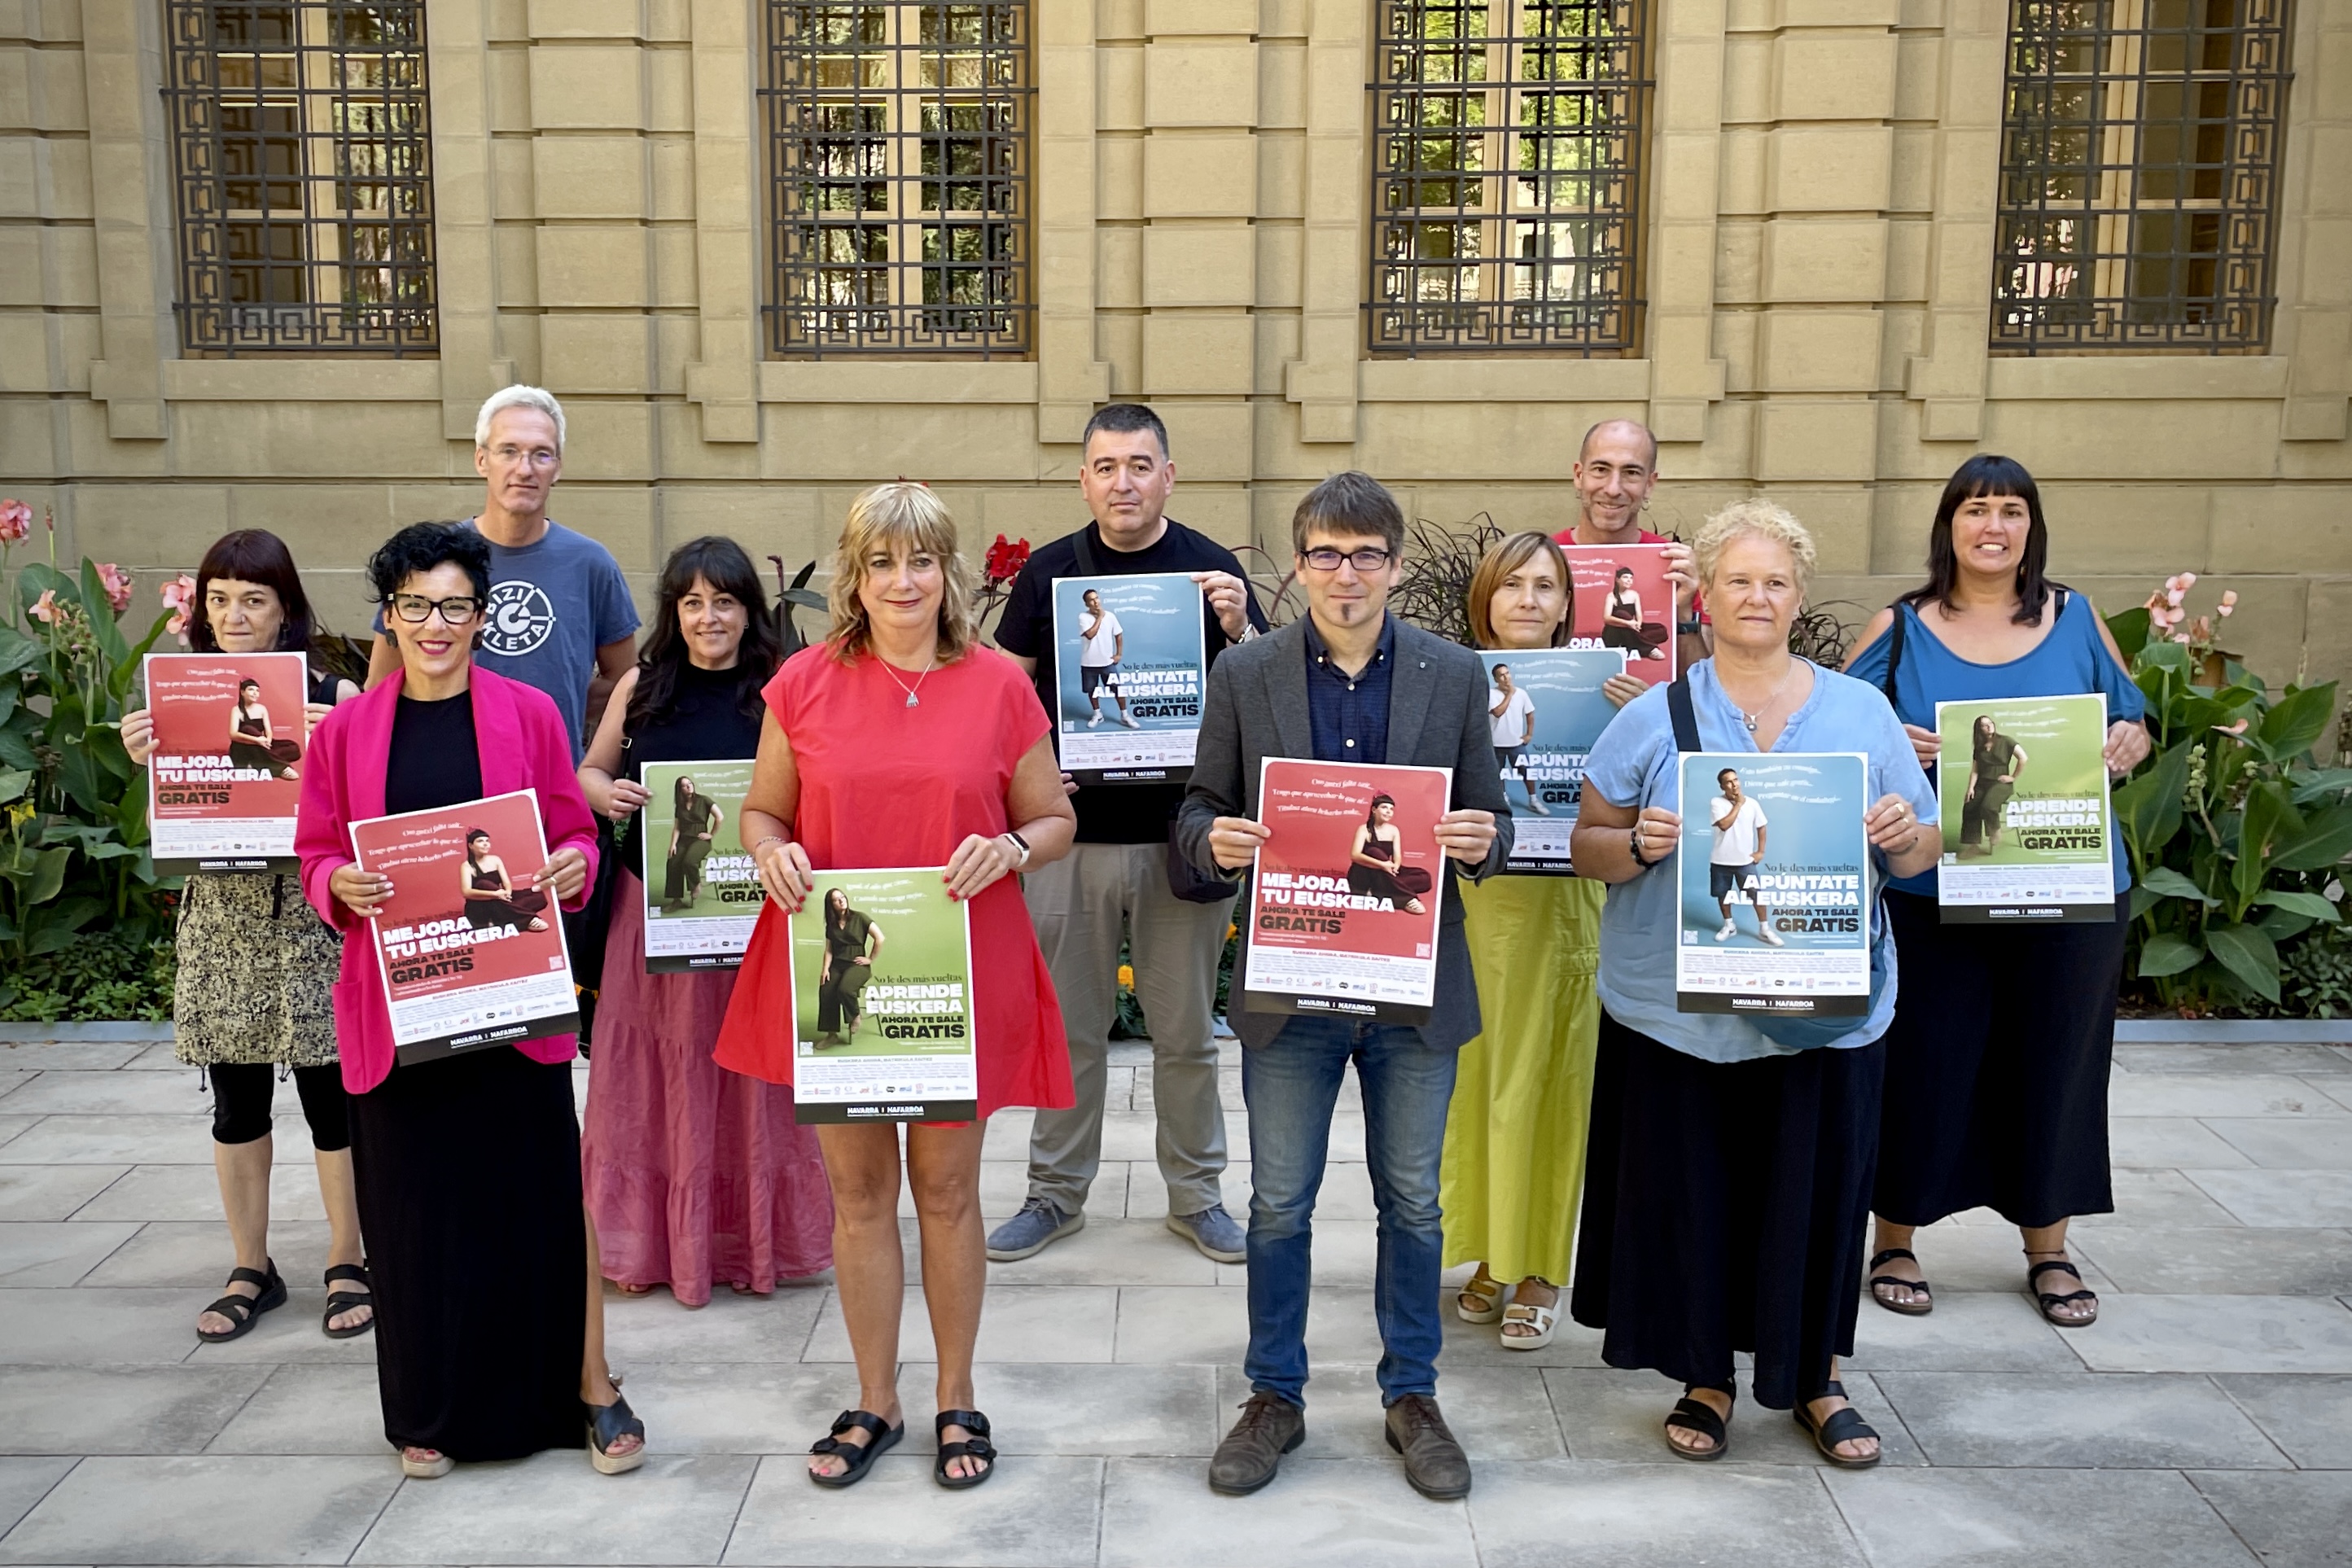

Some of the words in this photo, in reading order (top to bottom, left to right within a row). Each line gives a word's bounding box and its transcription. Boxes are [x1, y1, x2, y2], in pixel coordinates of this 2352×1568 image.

[485, 588, 523, 615] BIZI
[482, 621, 545, 649] KLETA
[1106, 670, 1198, 685] APÚNTATE
[1093, 686, 1115, 699] AL
[1118, 683, 1198, 698] EUSKERA
[1133, 705, 1198, 717] GRATIS
[156, 756, 234, 769] MEJORA
[156, 771, 182, 782] TU
[186, 769, 273, 782] EUSKERA
[1500, 768, 1523, 781] AL
[1526, 769, 1584, 781] EUSKE
[158, 791, 230, 804] GRATIS
[1543, 791, 1581, 803] GRA
[2006, 799, 2100, 813] APRENDE
[2007, 813, 2100, 827] EUSKERA
[2024, 836, 2101, 849] GRATIS
[1779, 863, 1788, 871] le
[1790, 863, 1806, 872] des
[1808, 863, 1826, 872] más
[1828, 863, 1859, 872] vueltas
[1263, 872, 1351, 892] MEJORA
[1743, 873, 1859, 889] APÚNTATE
[721, 891, 769, 902] GRAT
[1261, 889, 1291, 904] TU
[1294, 892, 1395, 913] EUSKERA
[1723, 891, 1753, 904] AL
[1757, 891, 1859, 905] EUSKERA
[1260, 906, 1299, 914] AHORA
[1318, 909, 1345, 918] SALE
[383, 917, 472, 944] MEJORA
[1259, 915, 1342, 934] GRATIS
[1776, 918, 1859, 932] GRATIS
[386, 942, 416, 959] TU
[420, 923, 519, 954] EUSKERA
[389, 957, 427, 969] AHORA
[447, 948, 474, 957] SALE
[392, 957, 473, 983] GRATIS
[931, 974, 962, 982] vueltas
[865, 983, 962, 999] APRENDE
[866, 1000, 964, 1014] EUSKERA
[1298, 999, 1330, 1007] NAVARRA
[1338, 1002, 1376, 1013] NAFARROA
[451, 1035, 483, 1045] NAVARRA
[490, 1027, 528, 1038] NAFARROA
[885, 1024, 965, 1038] GRATIS
